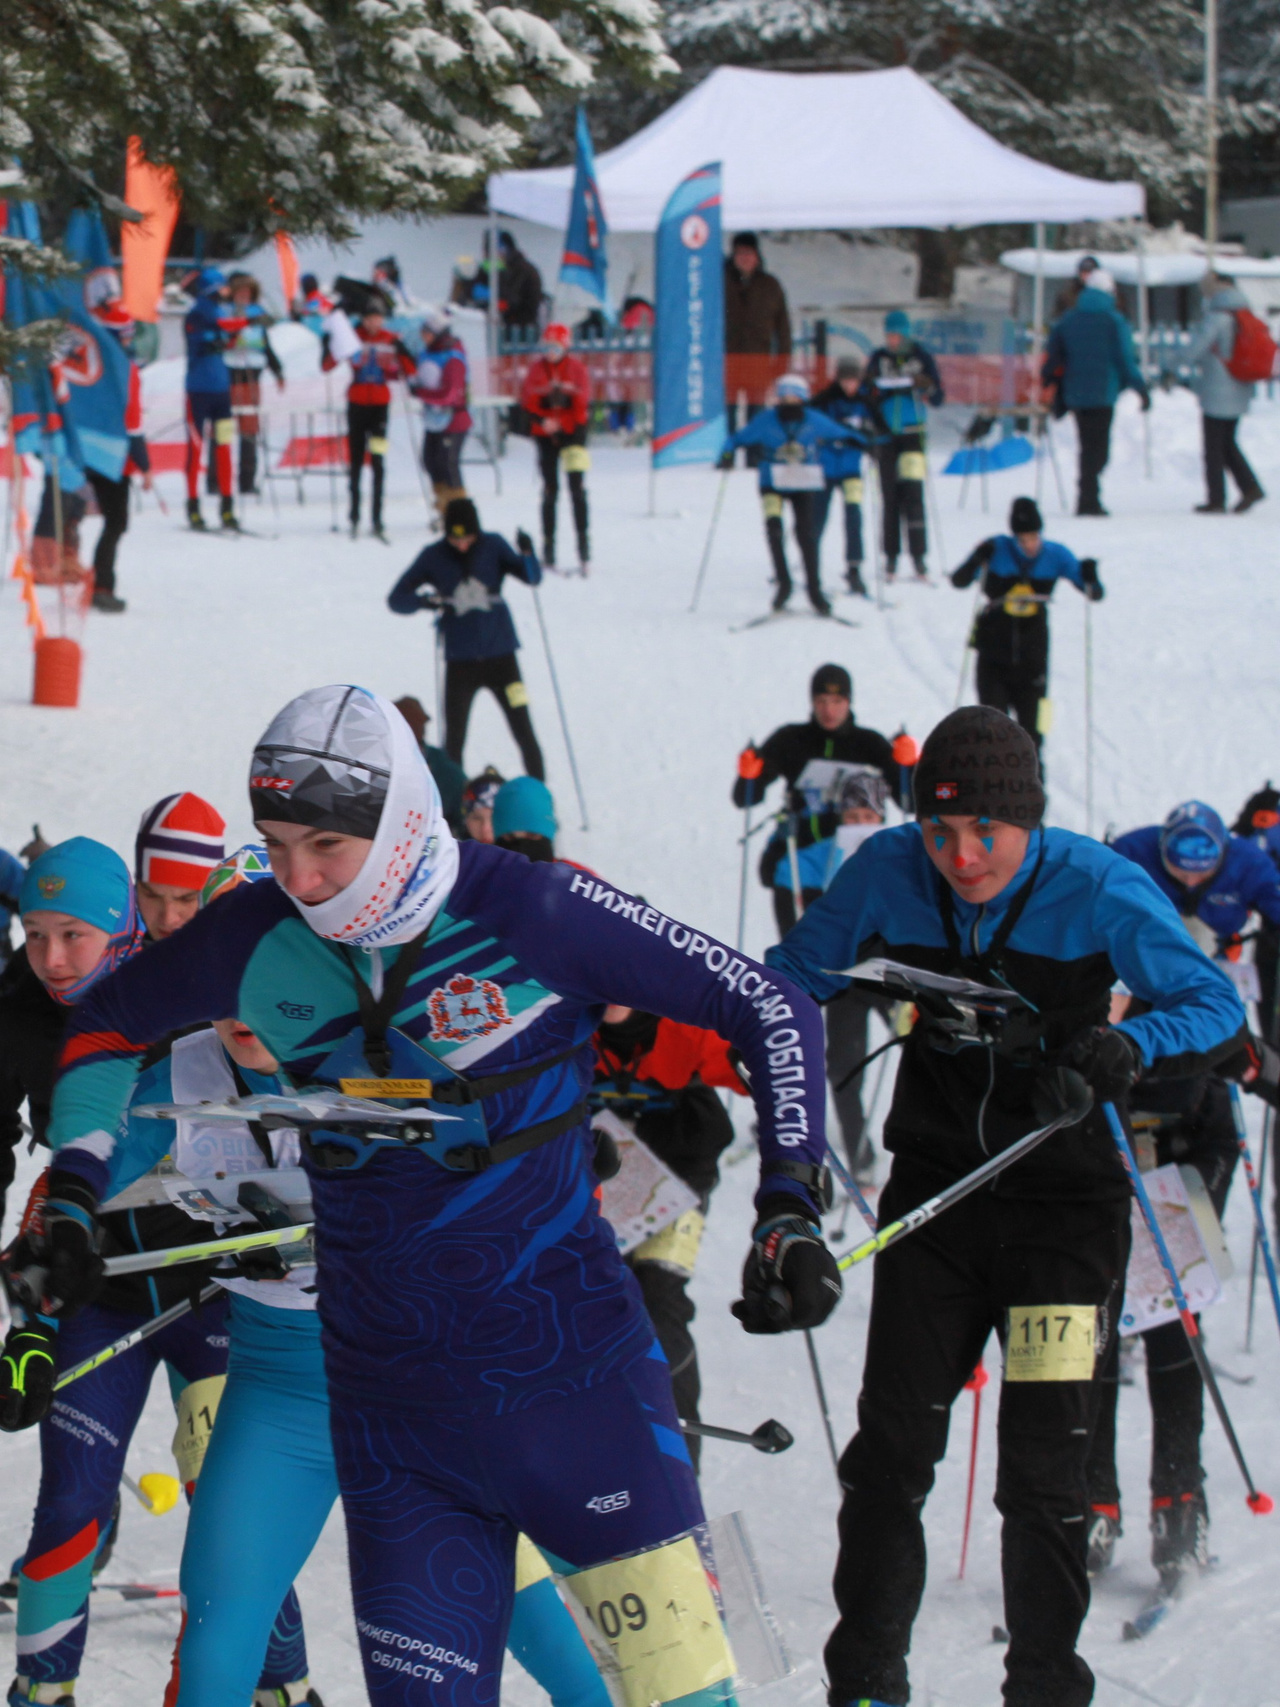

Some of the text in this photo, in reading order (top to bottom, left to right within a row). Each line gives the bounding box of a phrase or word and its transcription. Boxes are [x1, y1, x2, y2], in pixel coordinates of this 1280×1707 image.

[569, 873, 810, 1148] НИЖЕГОРОДСКАЯ ОБЛАСТЬ
[1020, 1316, 1071, 1343] 117
[50, 1414, 96, 1447] ОБЛАСТЬ
[371, 1651, 444, 1684] ОБЛАСТЬ
